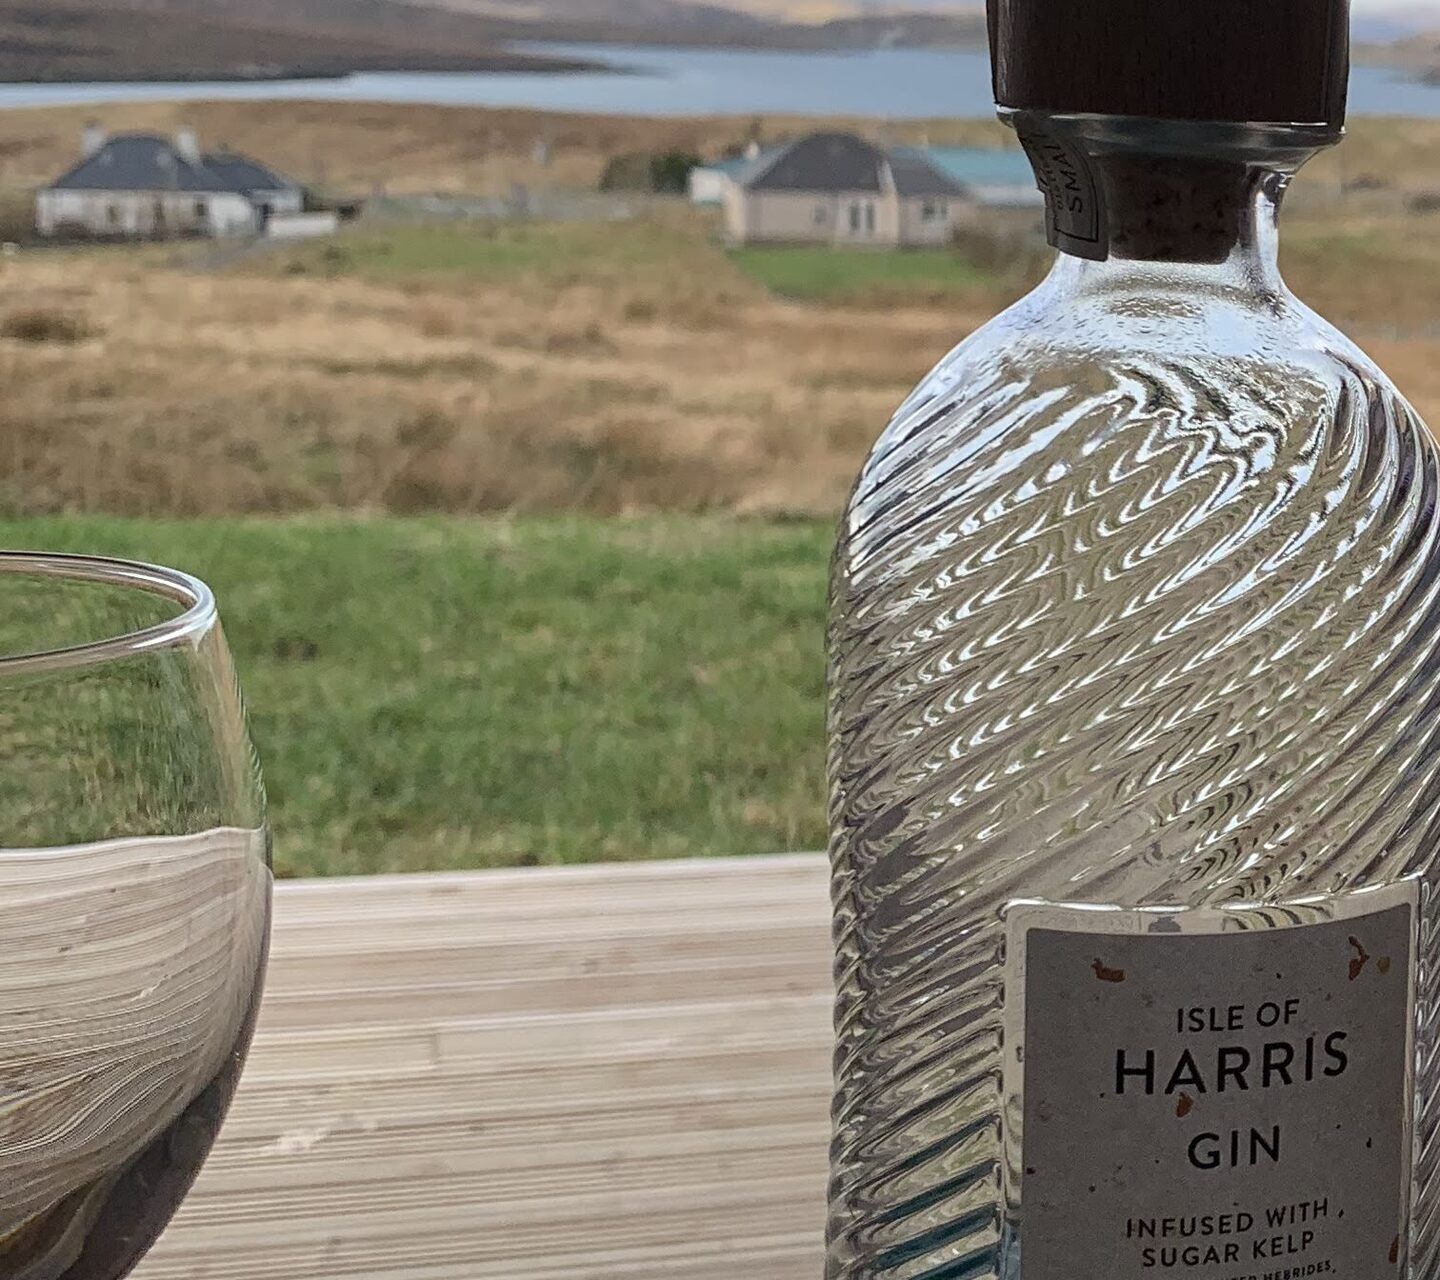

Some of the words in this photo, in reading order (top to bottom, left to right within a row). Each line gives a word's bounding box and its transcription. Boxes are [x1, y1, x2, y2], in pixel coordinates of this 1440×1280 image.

[1176, 1005, 1244, 1032] ISLE
[1256, 999, 1300, 1027] OF
[1115, 1031, 1348, 1095] HARRIS
[1187, 1125, 1281, 1170] GIN
[1126, 1213, 1254, 1239] INFUSED
[1265, 1197, 1329, 1228] WITH
[1142, 1243, 1240, 1268] SUGAR
[1252, 1230, 1315, 1259] KELP
